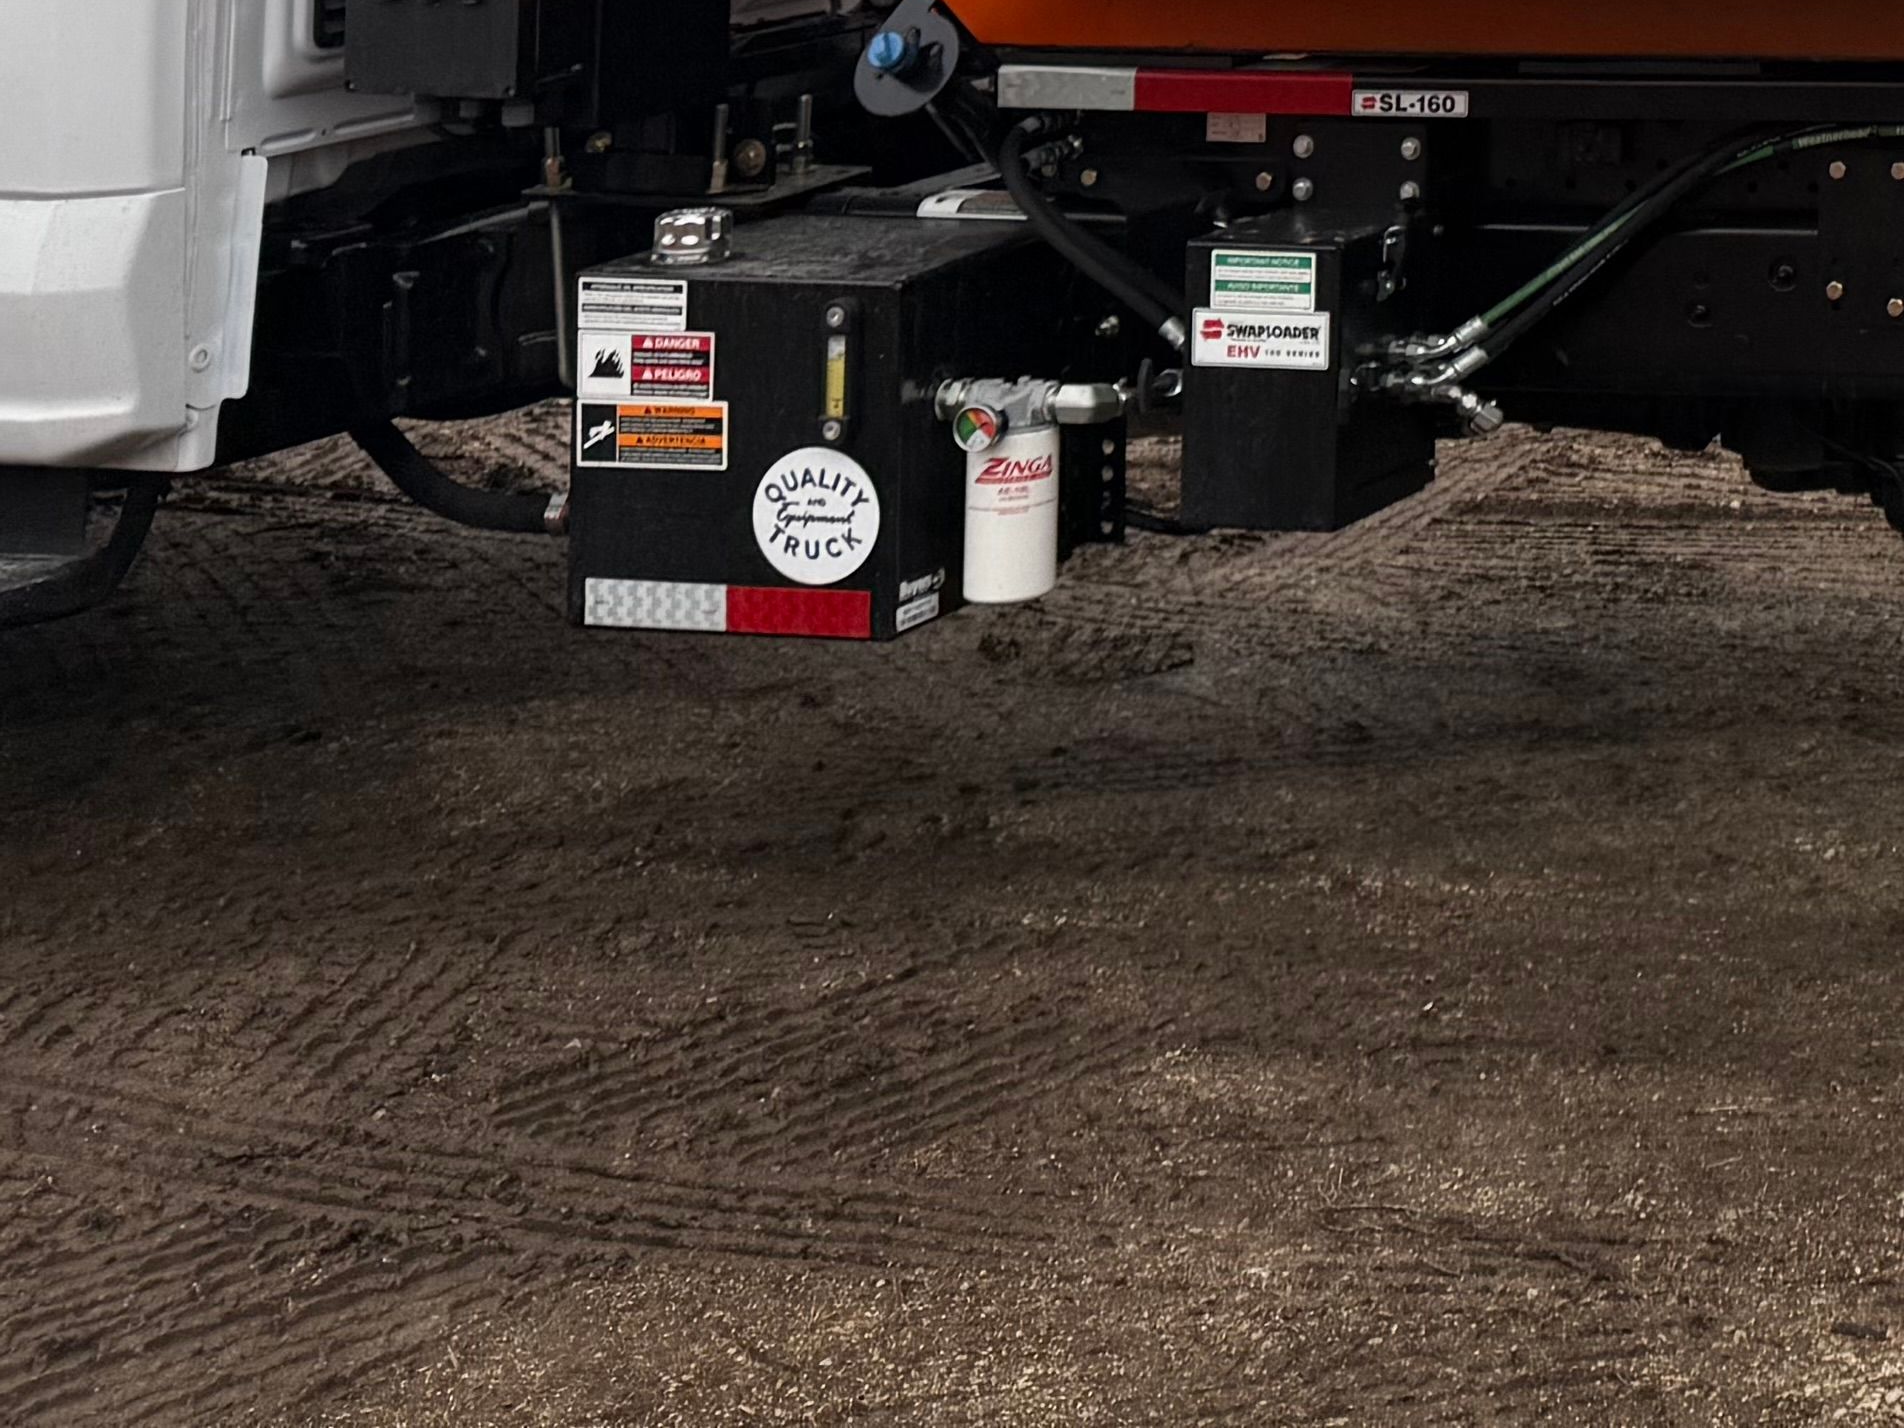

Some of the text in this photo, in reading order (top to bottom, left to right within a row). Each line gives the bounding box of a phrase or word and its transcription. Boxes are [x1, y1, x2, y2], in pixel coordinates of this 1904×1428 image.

[1379, 93, 1456, 113] SL-160
[1227, 323, 1320, 340] SWAPLOADER
[655, 337, 700, 350] DANGER
[1227, 345, 1260, 359] EHV
[655, 368, 702, 381] PELIGRO
[765, 467, 870, 507] QUALITY
[777, 501, 855, 529] Equipment
[768, 523, 862, 560] TRUCK
